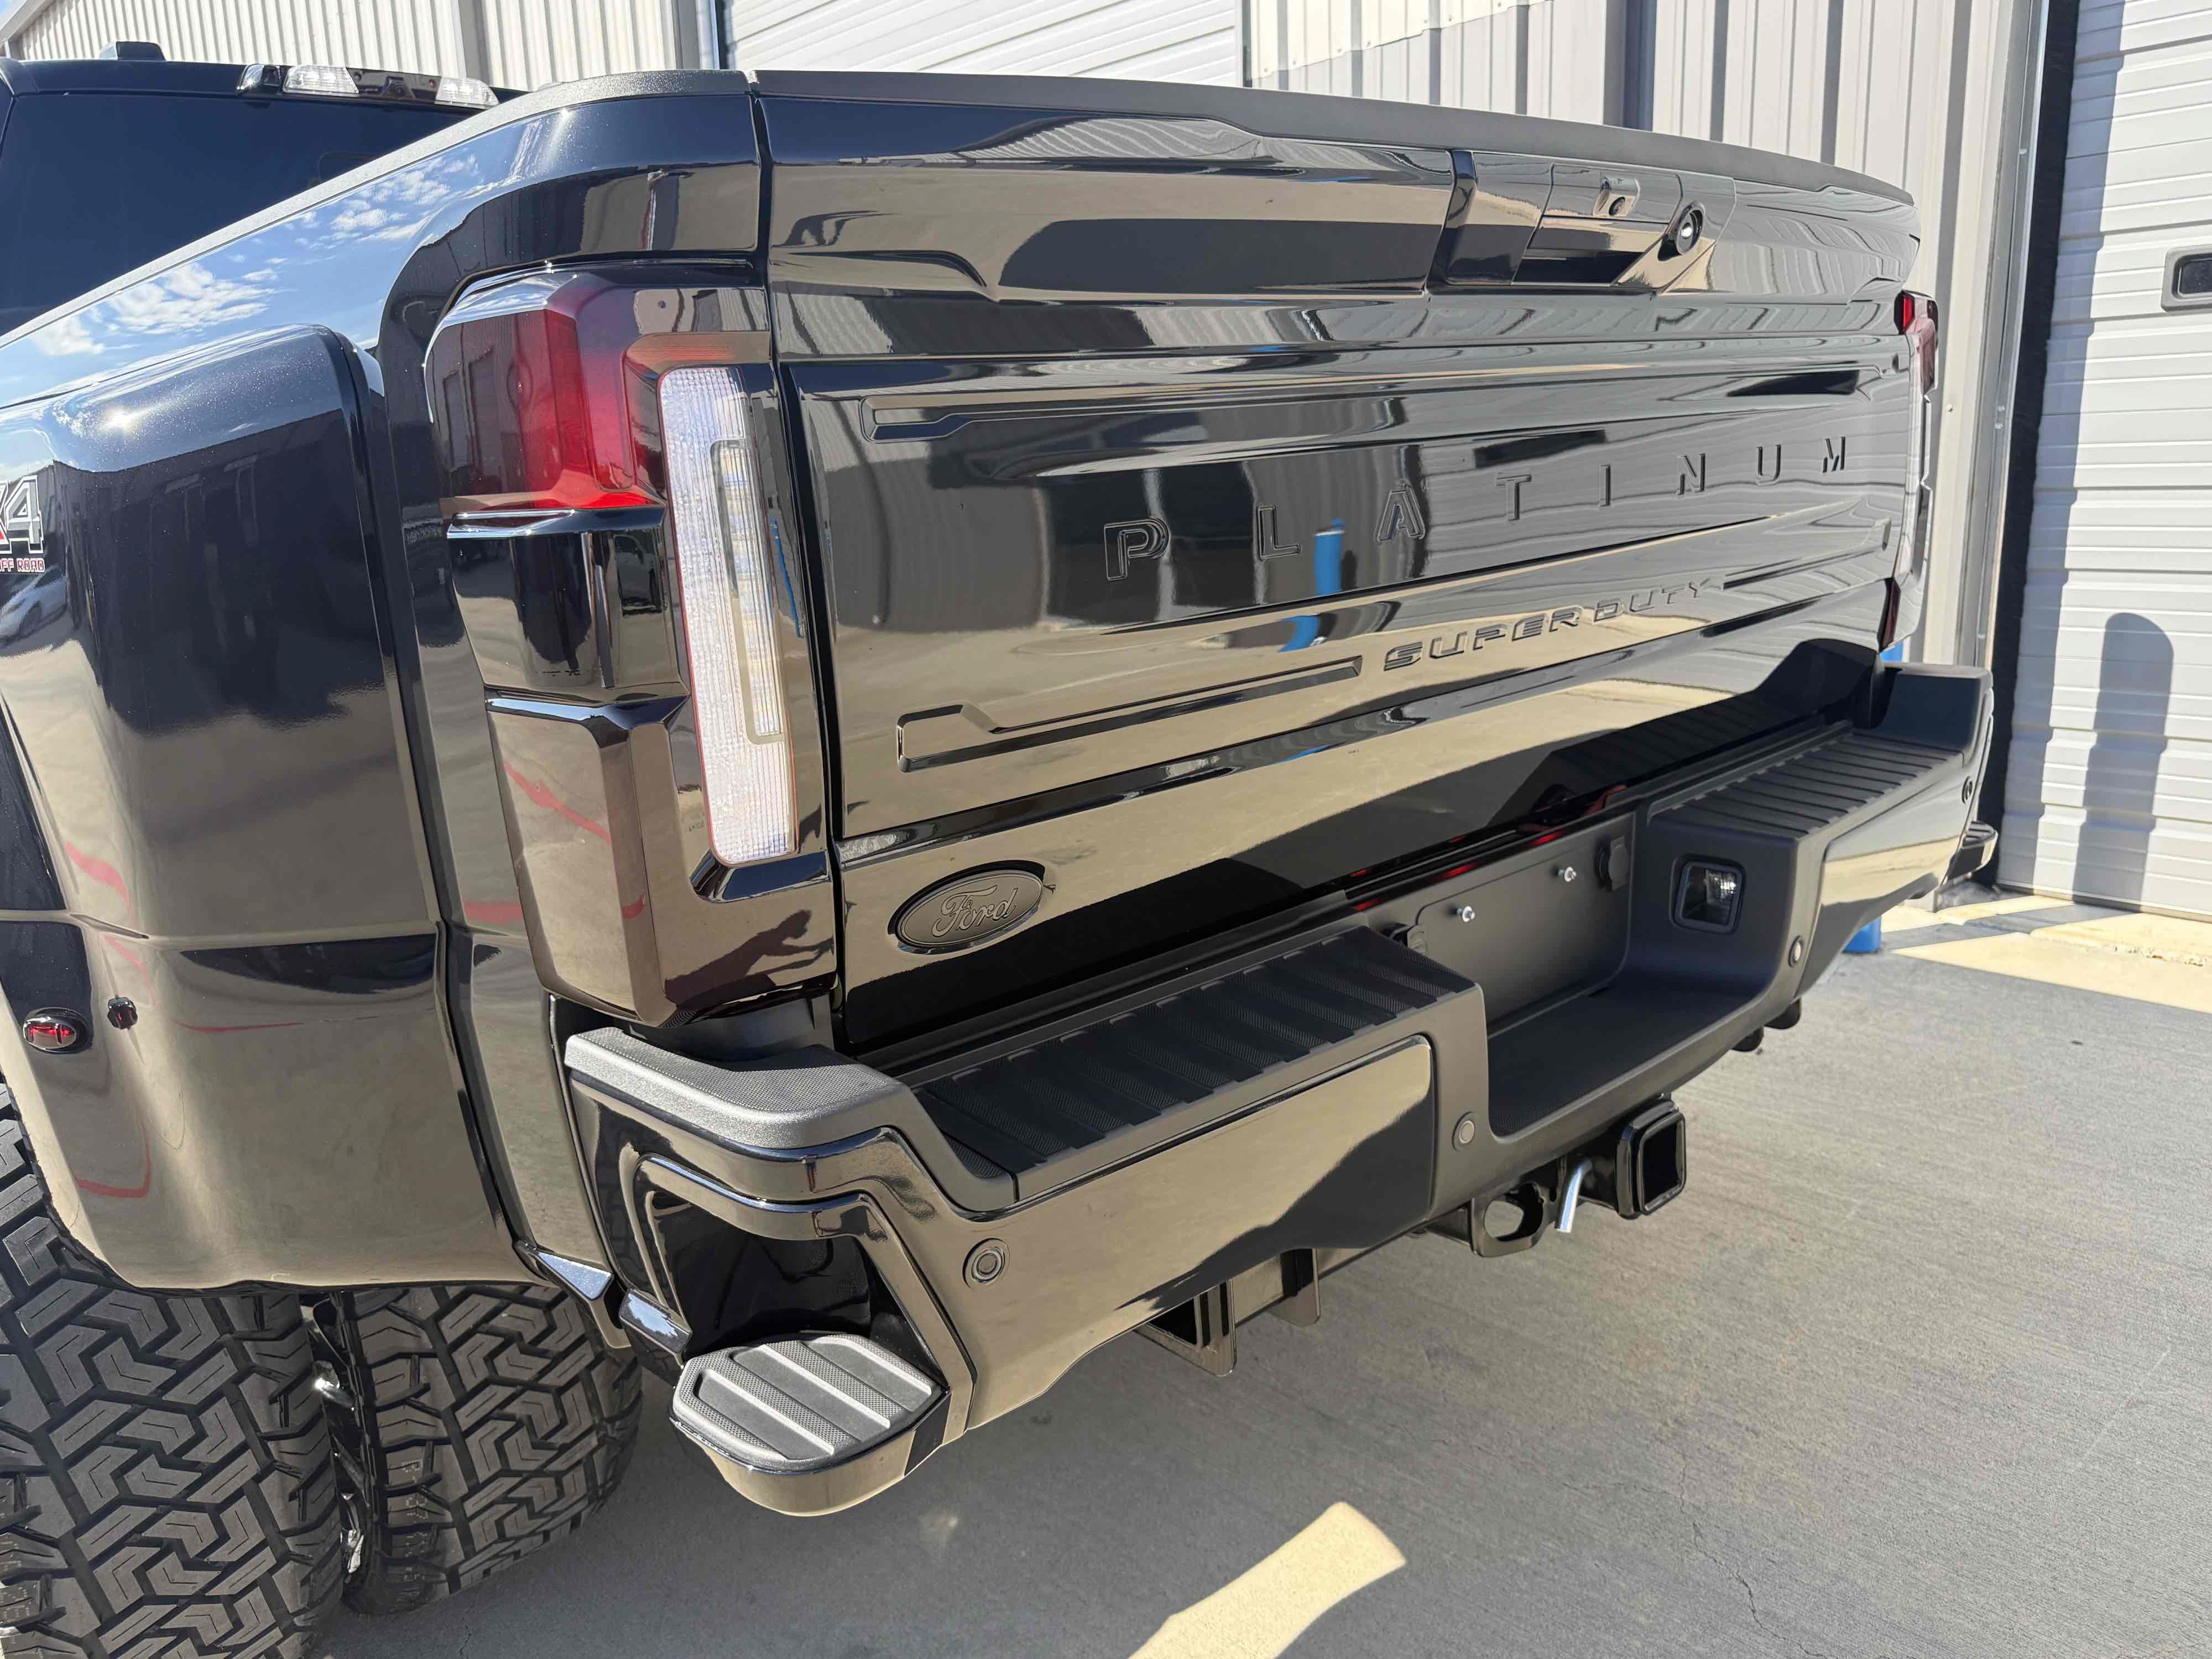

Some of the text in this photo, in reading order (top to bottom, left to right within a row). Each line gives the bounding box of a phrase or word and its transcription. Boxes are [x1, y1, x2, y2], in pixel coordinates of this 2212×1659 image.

[1104, 436, 1846, 581] PLATINUM
[0, 557, 45, 572] FF ROAD
[1383, 578, 1711, 671] SUPER DUTY
[931, 885, 1019, 937] Ford
